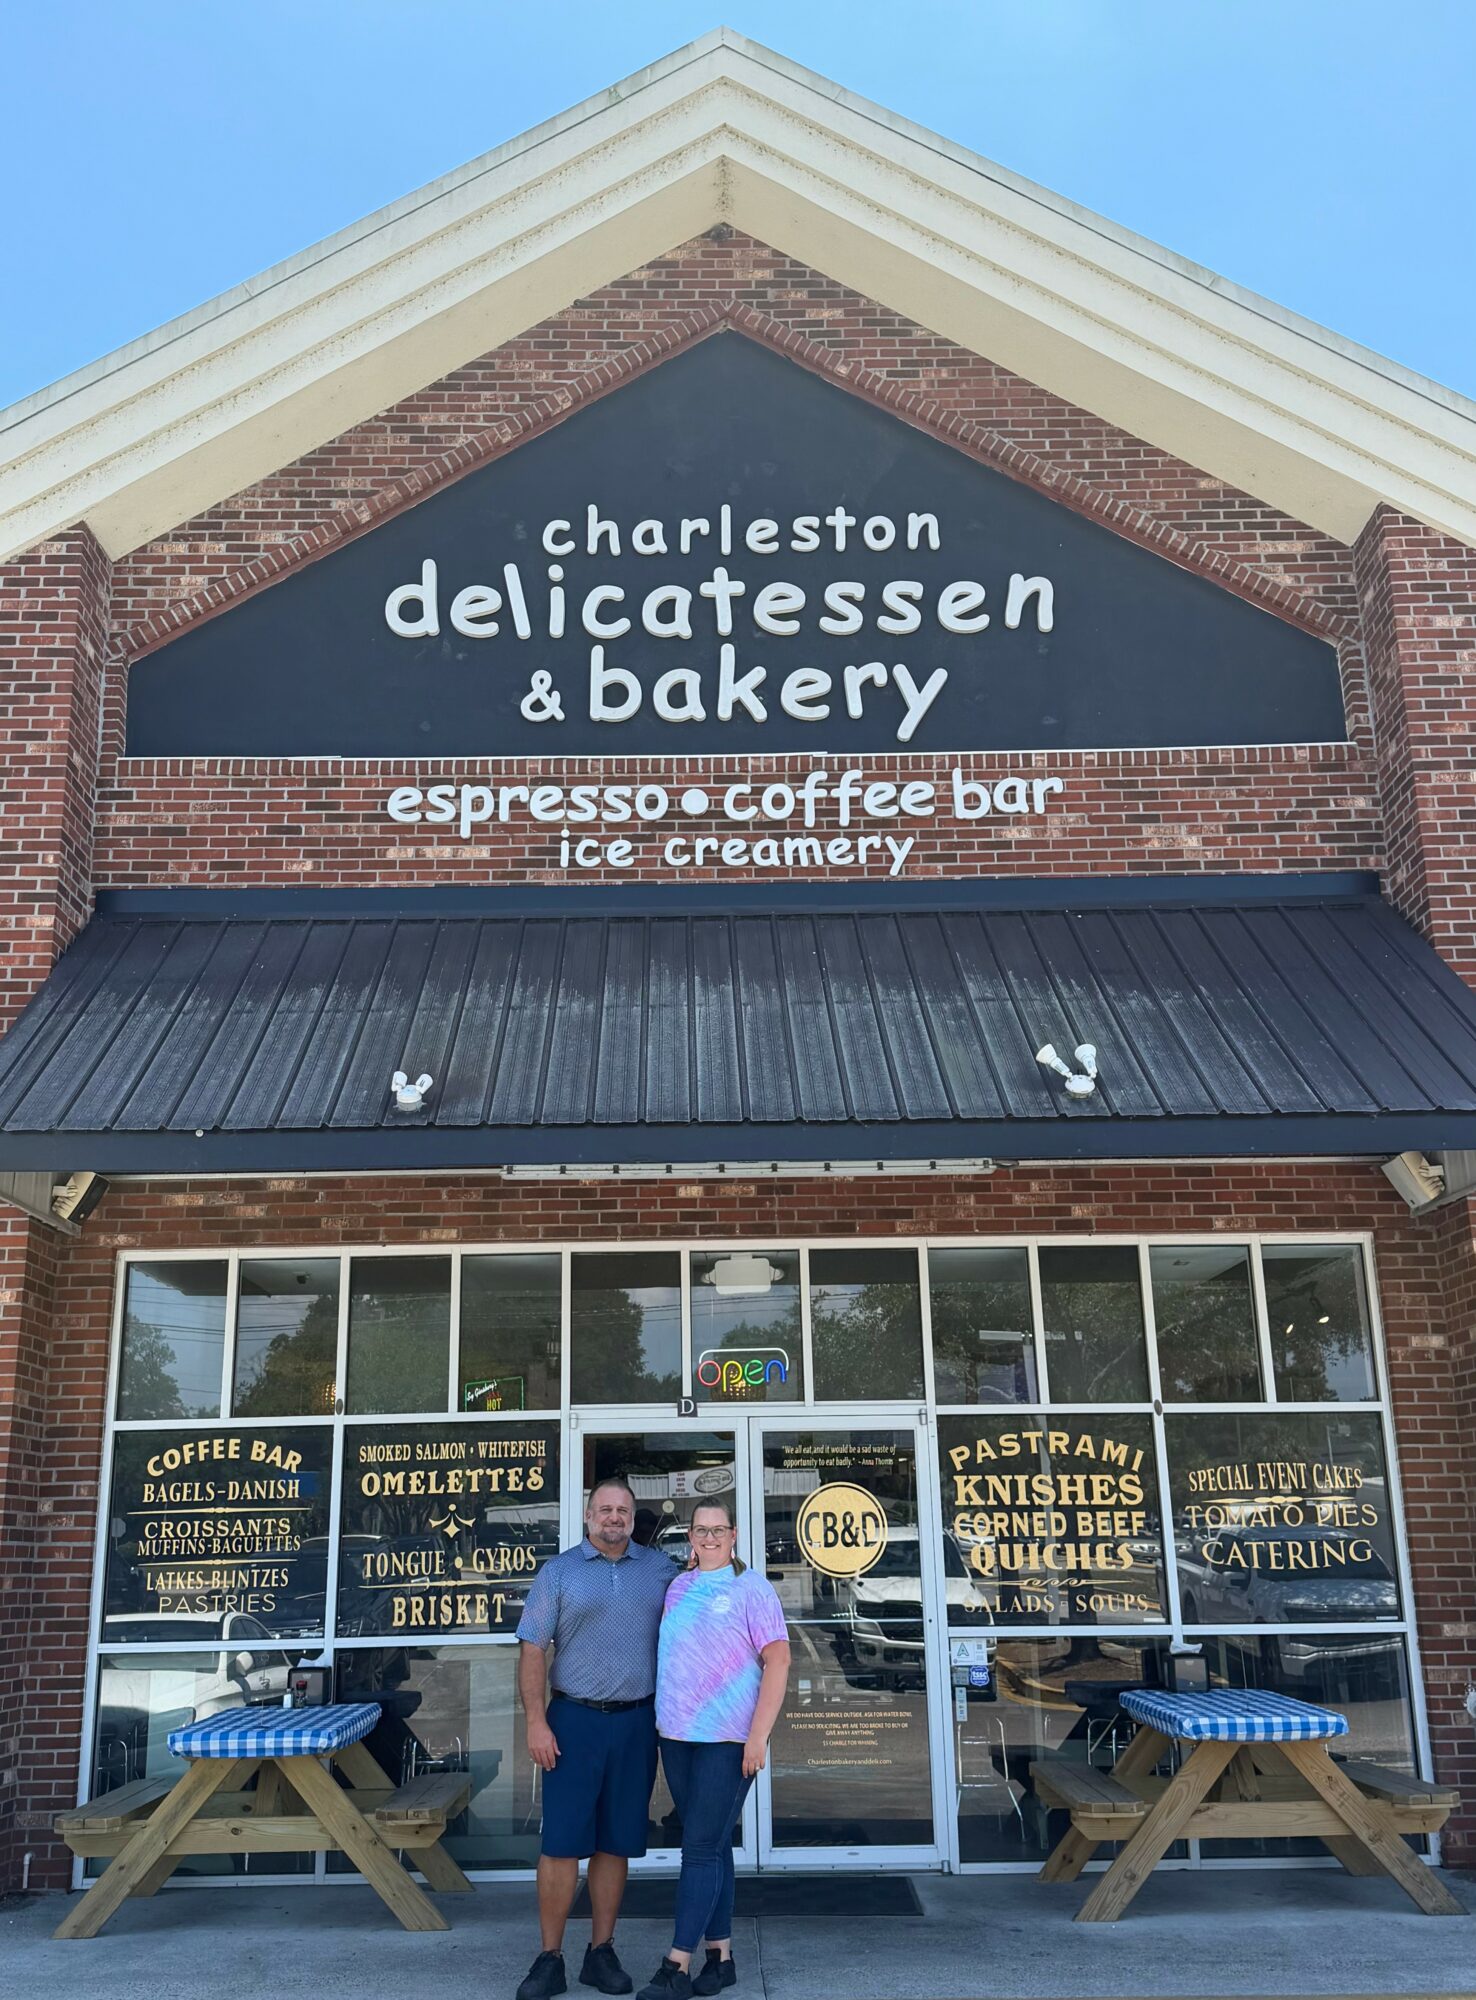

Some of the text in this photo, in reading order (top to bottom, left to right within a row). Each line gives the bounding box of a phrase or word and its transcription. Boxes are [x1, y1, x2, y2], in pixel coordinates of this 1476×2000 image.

[542, 504, 941, 556] charleston
[385, 558, 1054, 640] delicatessen
[520, 643, 948, 742] & bakery
[387, 768, 1063, 839] espresso coffee bar
[561, 829, 915, 877] ice creamery
[697, 1359, 786, 1393] open
[487, 1398, 501, 1411] HOT
[680, 1398, 695, 1415] D
[147, 1438, 303, 1478] COFFEE BAR
[359, 1440, 546, 1463] SMOKED SALMON WHITEFISH
[949, 1430, 1145, 1472] PASTRAMI
[361, 1466, 545, 1497] OMELETTES
[953, 1474, 1144, 1506] KNISHES
[1188, 1462, 1363, 1492] SPECIAL EVENT CAKES
[144, 1518, 292, 1539] CROISSANTS
[804, 1511, 880, 1548] CB&D
[954, 1511, 1146, 1537] CORNED BEEF
[1184, 1503, 1378, 1529] TOMATO PIES
[363, 1546, 537, 1578] TONGUE GYROS
[970, 1542, 1134, 1577] QUICHES
[1201, 1539, 1372, 1570] CATERING
[159, 1593, 276, 1614] PASTRIES
[392, 1593, 506, 1627] BRISKET
[1076, 1593, 1149, 1613] SOUPS
